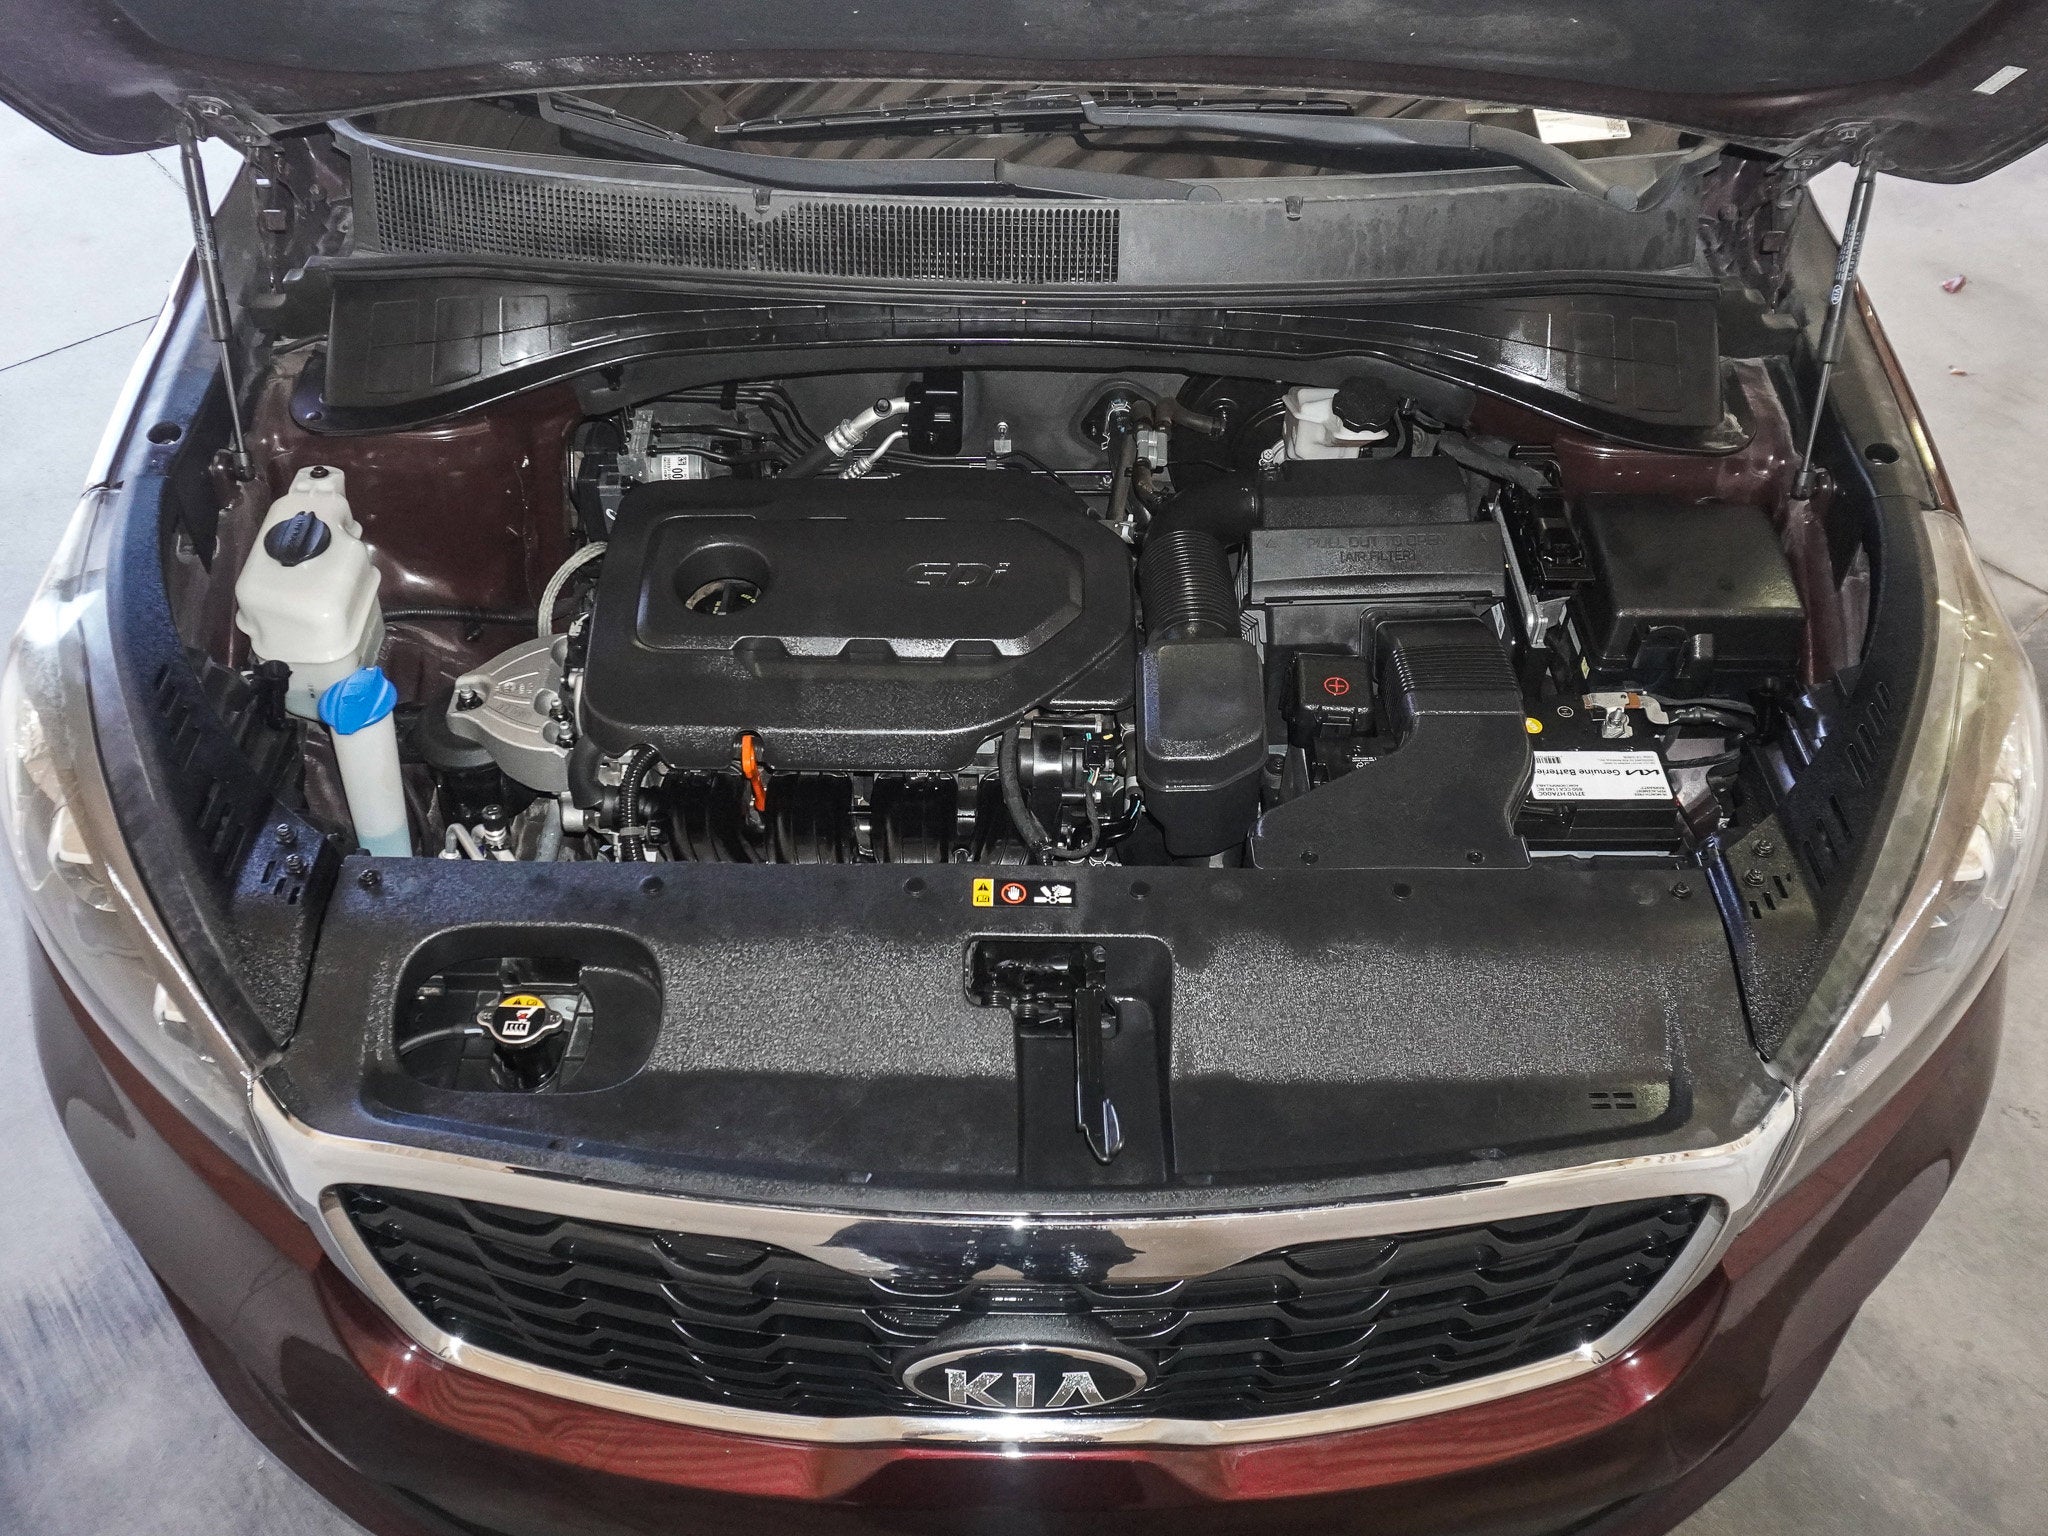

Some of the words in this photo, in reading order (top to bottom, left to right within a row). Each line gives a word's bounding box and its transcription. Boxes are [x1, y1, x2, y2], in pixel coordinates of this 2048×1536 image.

[1534, 768, 1577, 776] Batterie
[1579, 768, 1621, 776] Genuine
[945, 1368, 1106, 1408] KIA
